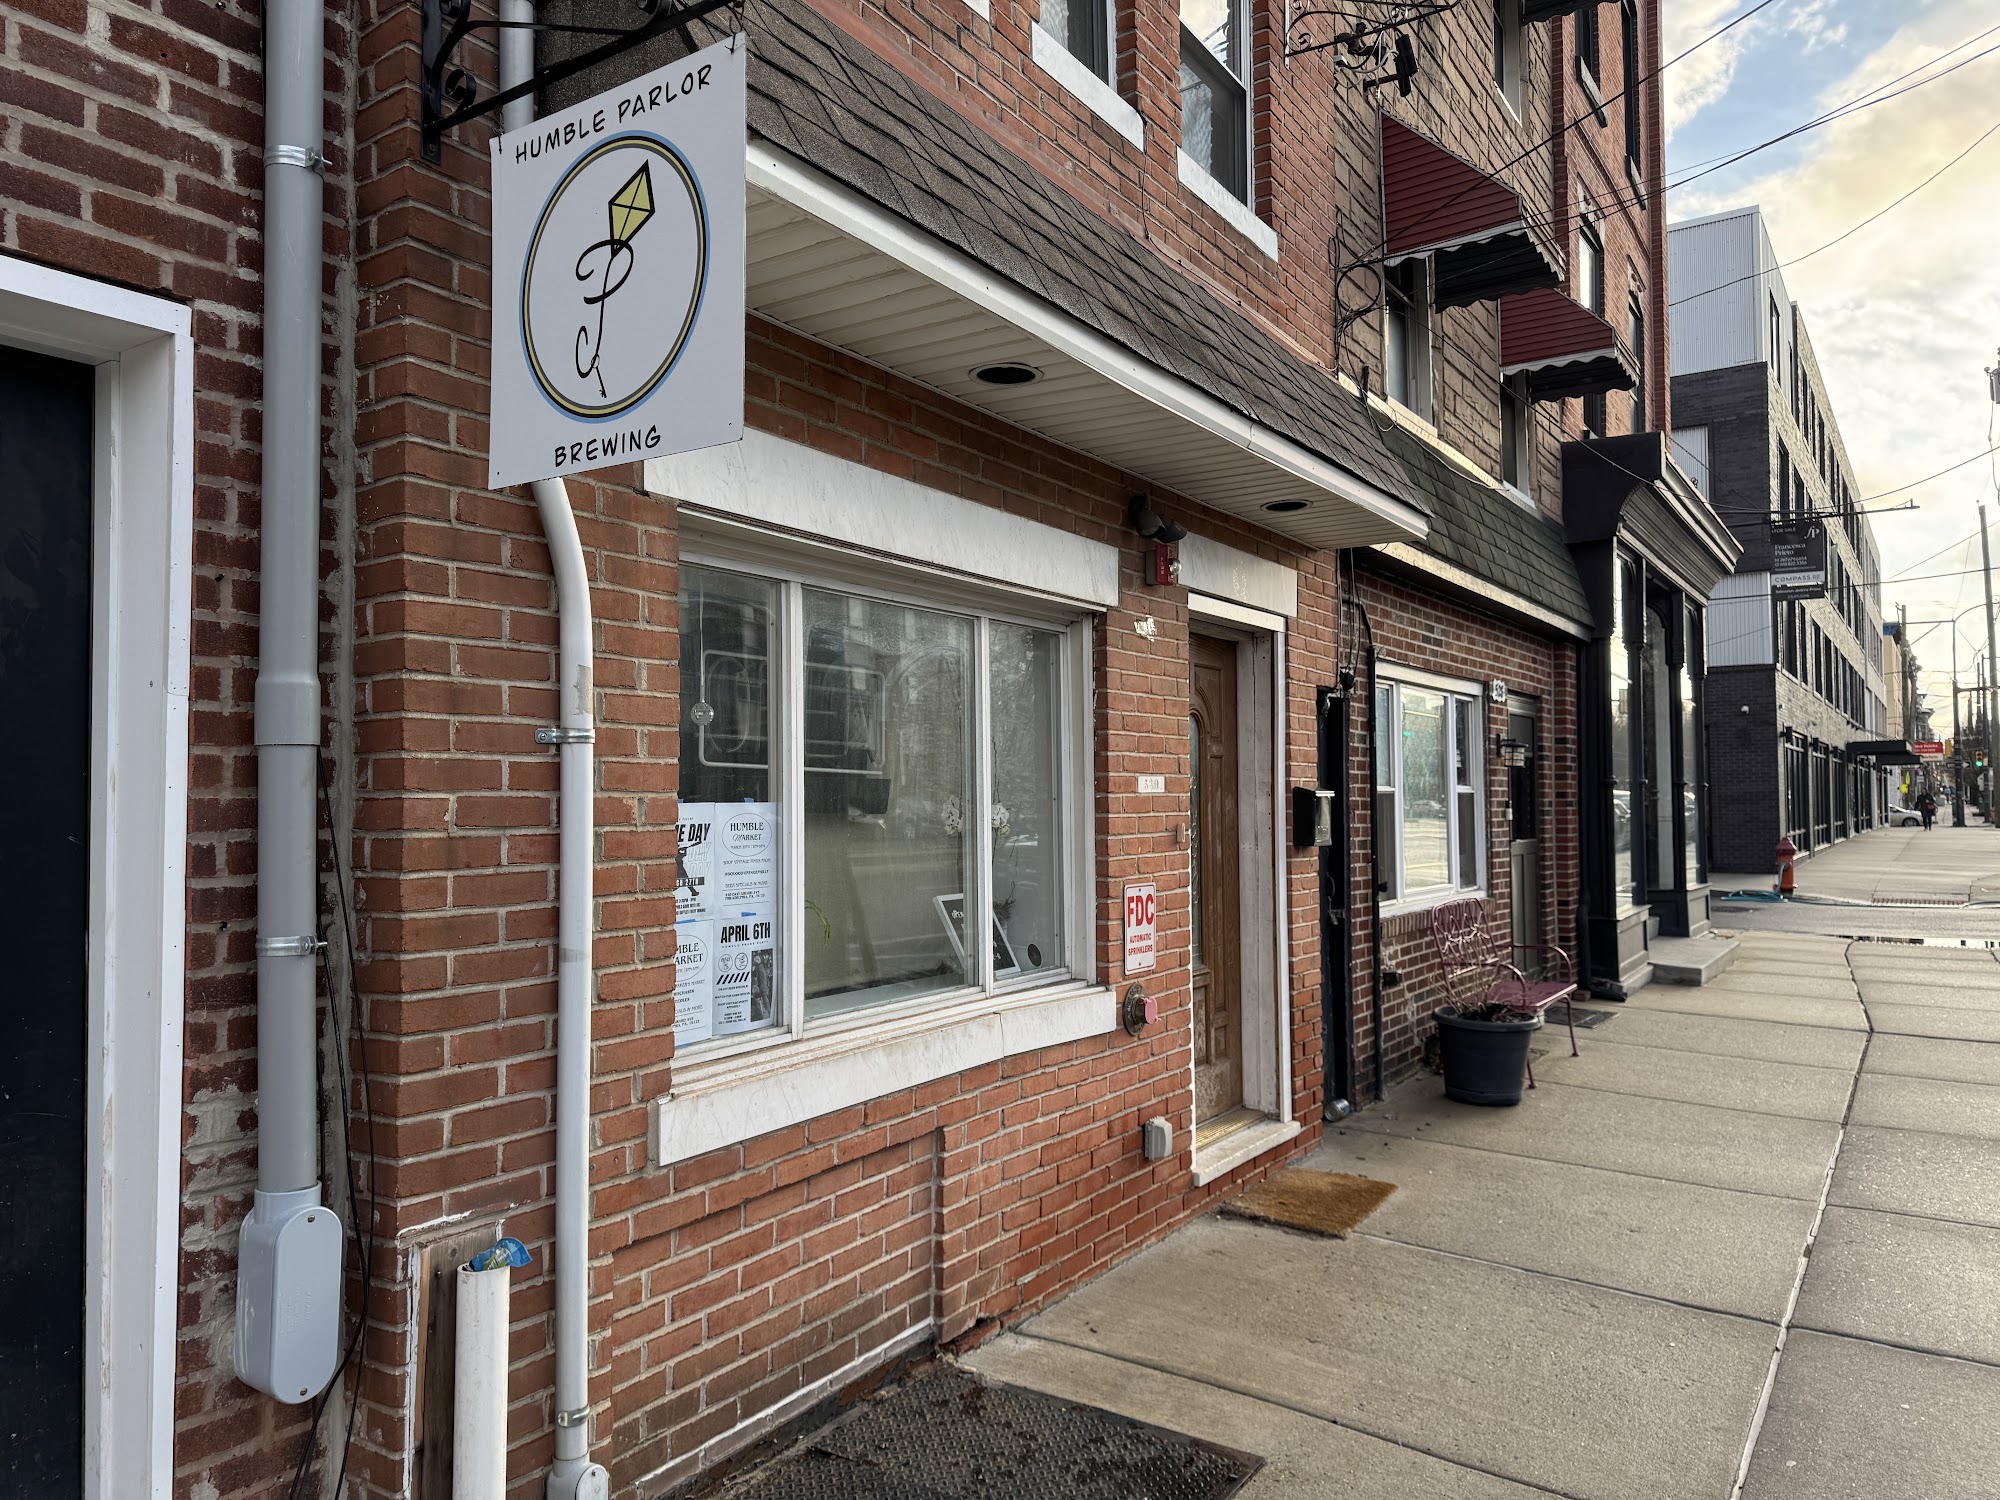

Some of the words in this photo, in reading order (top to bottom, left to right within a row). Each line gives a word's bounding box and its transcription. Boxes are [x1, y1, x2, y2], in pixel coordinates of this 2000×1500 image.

[515, 109, 605, 164] HUMBLE
[617, 64, 712, 124] PARLOR
[554, 424, 661, 468] BREWING
[1774, 575, 1811, 583] COMPASS
[688, 823, 711, 842] DAY
[730, 822, 765, 831] HUMBLE
[732, 833, 762, 842] MARKET
[1127, 893, 1154, 928] FDC
[720, 924, 750, 943] APRIL
[752, 922, 771, 940] 6TH
[1129, 933, 1152, 944] AUTOMATIC
[1128, 944, 1153, 957] SPRINKLERS
